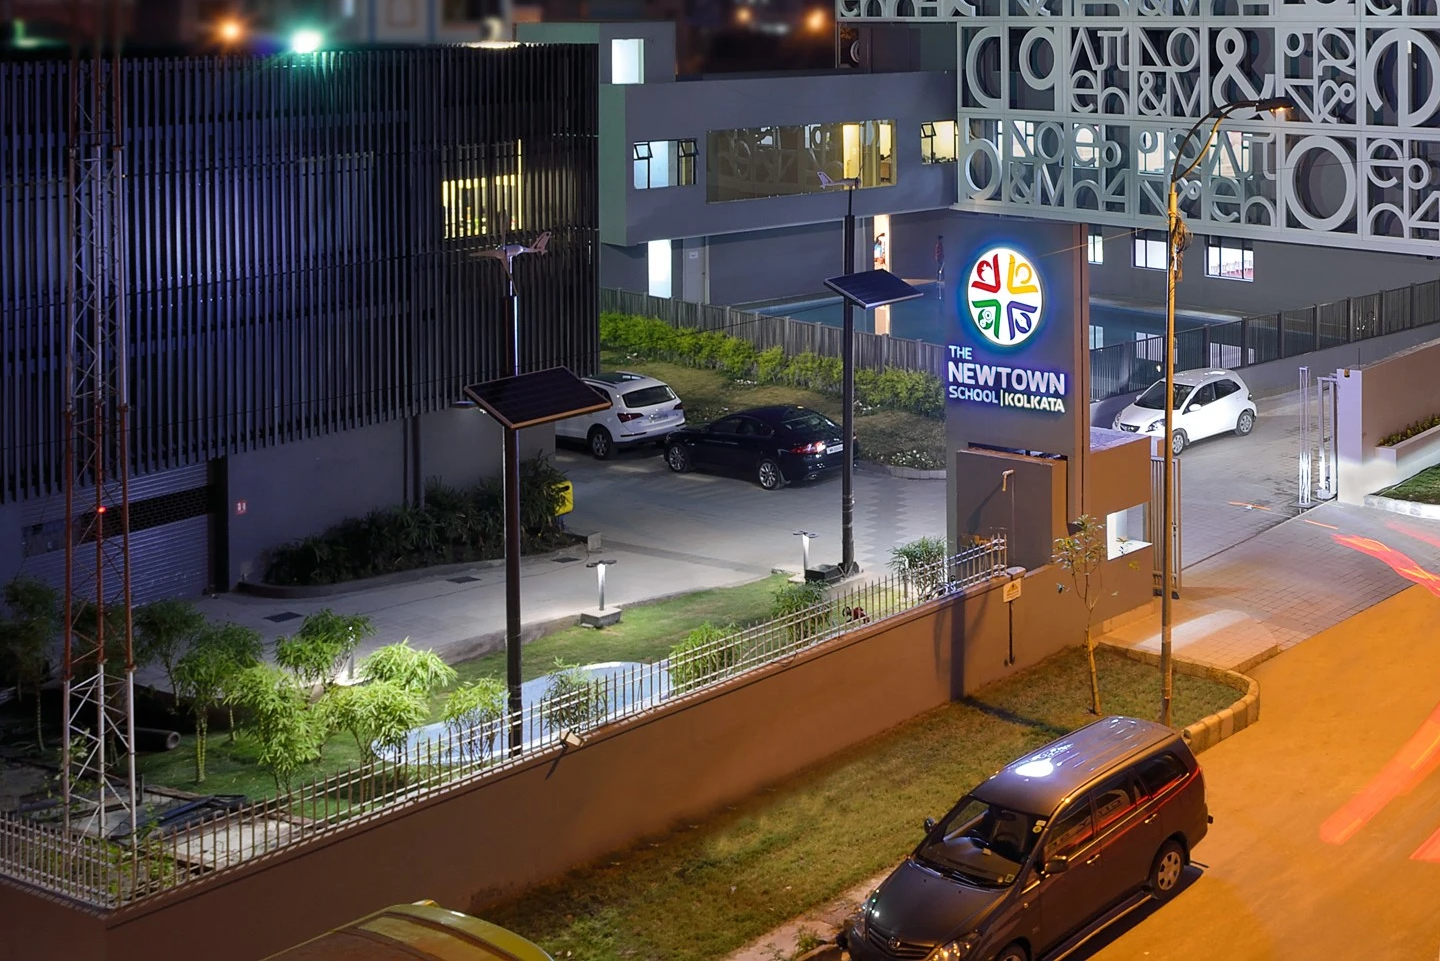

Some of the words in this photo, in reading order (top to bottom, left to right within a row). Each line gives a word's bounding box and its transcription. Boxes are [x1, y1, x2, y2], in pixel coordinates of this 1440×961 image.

[949, 345, 973, 360] THE
[948, 361, 1065, 395] NEWTOWN
[949, 386, 998, 405] SCHOOL
[1004, 391, 1066, 414] KOLKATA
